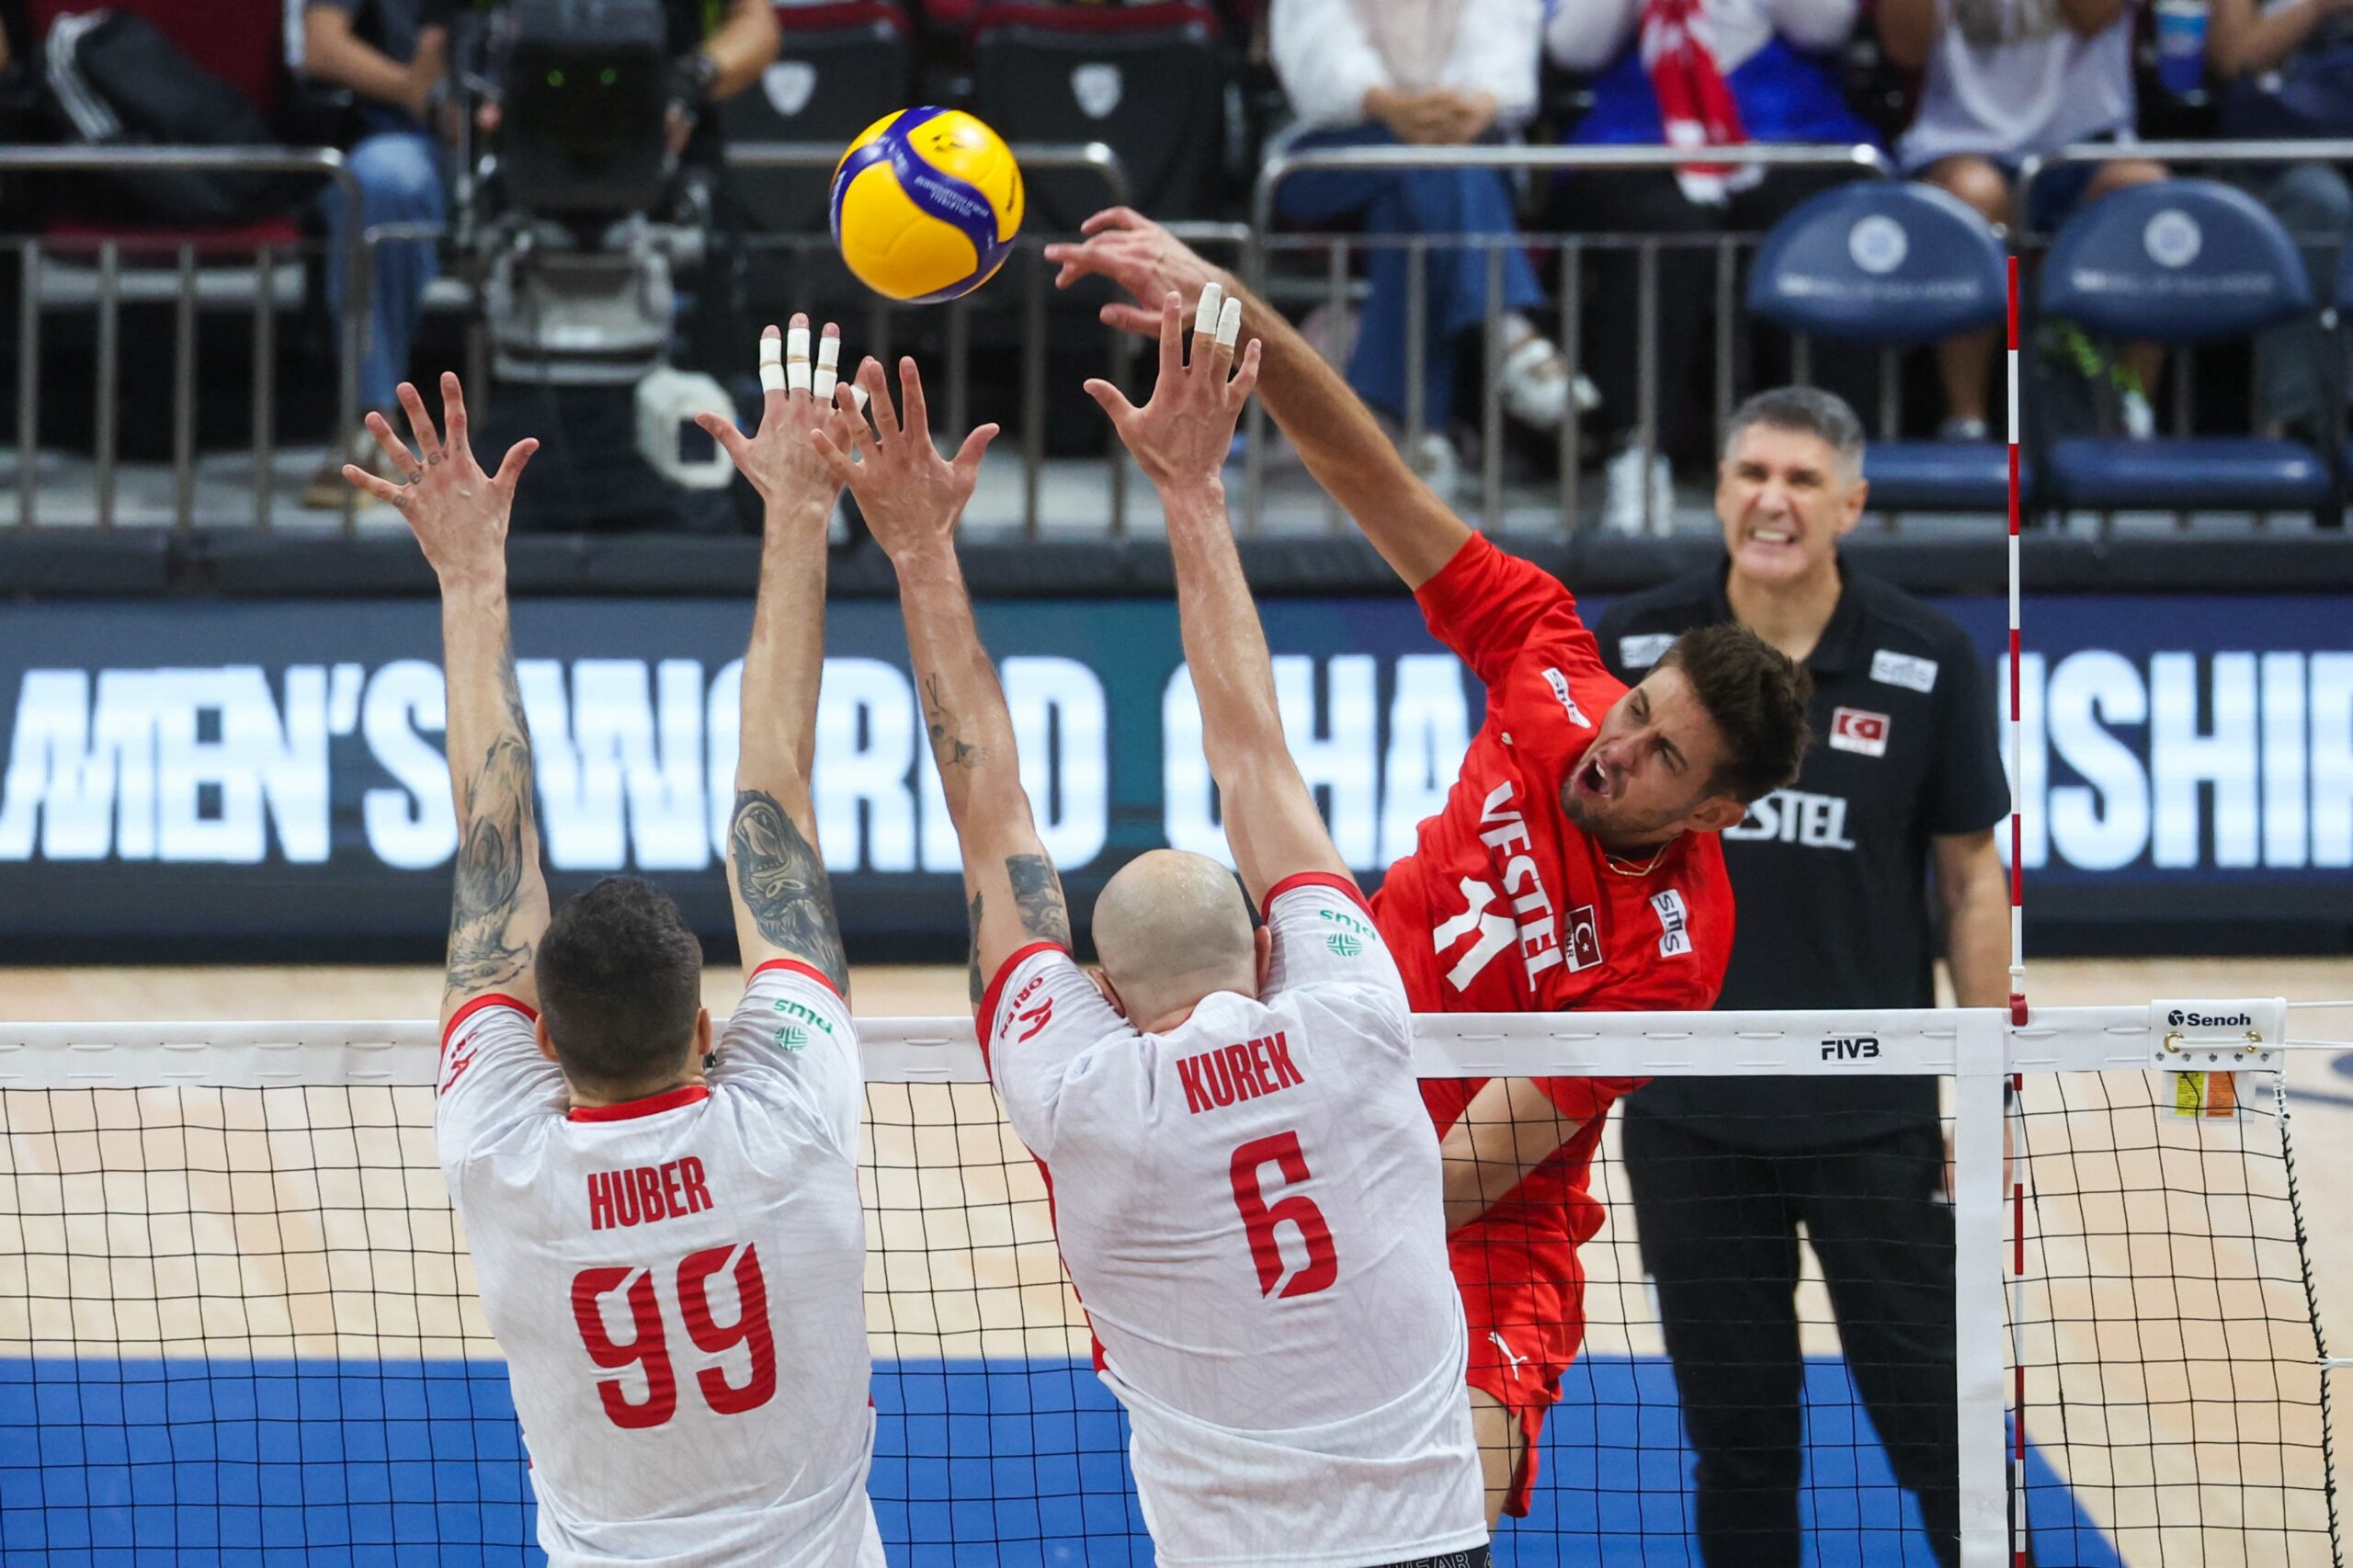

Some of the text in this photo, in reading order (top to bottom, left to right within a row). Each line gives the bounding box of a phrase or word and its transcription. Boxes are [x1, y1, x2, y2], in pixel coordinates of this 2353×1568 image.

[0, 659, 460, 870] MEN'S
[516, 656, 1108, 873] WRD
[1722, 788, 1856, 851] STEL
[1479, 779, 1563, 993] VESTEL
[1821, 1038, 1881, 1061] FIVB
[2187, 1013, 2251, 1027] Senoh
[1176, 1030, 1305, 1115] KUREK
[587, 1155, 714, 1231] HUBER
[1229, 1129, 1338, 1300] 6
[570, 1240, 778, 1430] 99
